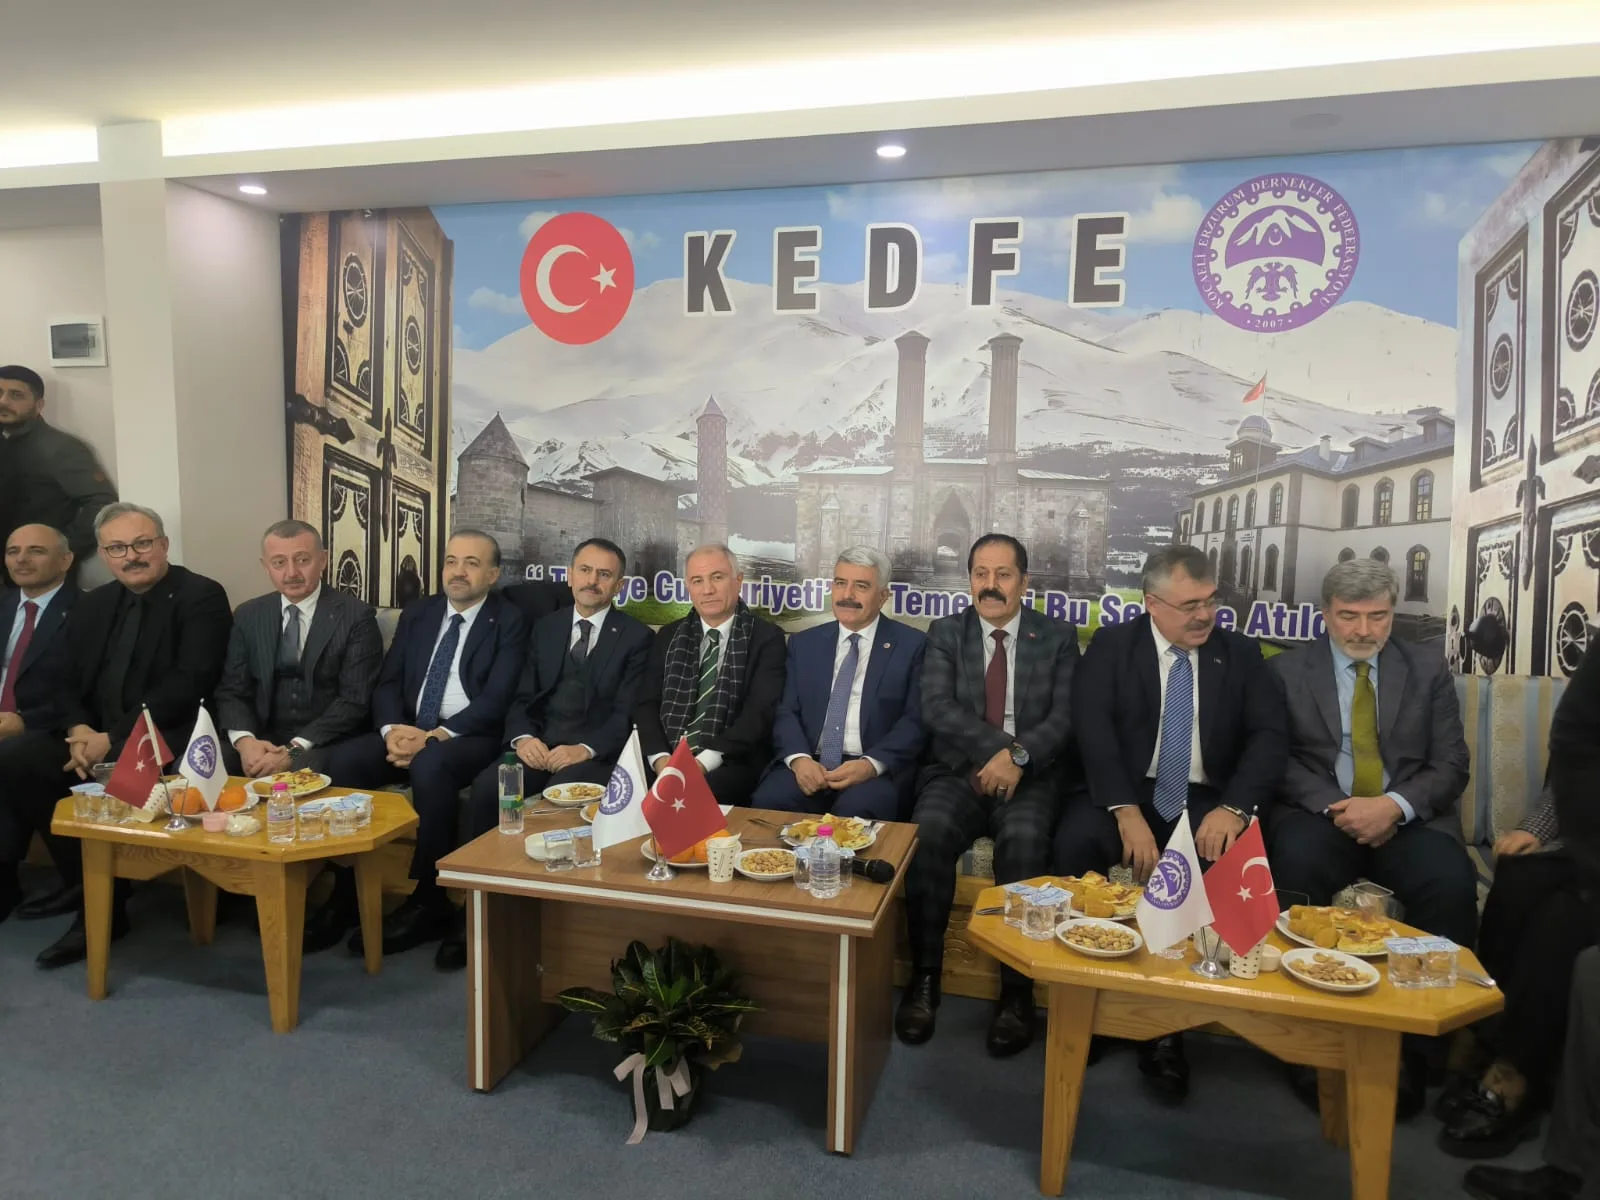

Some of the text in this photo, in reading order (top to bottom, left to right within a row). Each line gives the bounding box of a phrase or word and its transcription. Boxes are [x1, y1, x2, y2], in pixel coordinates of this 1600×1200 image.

[1198, 189, 1245, 247] ERZURUM
[1250, 176, 1334, 203] DERNEKLER
[1254, 318, 1285, 329] 2007
[1045, 590, 1090, 627] Bu
